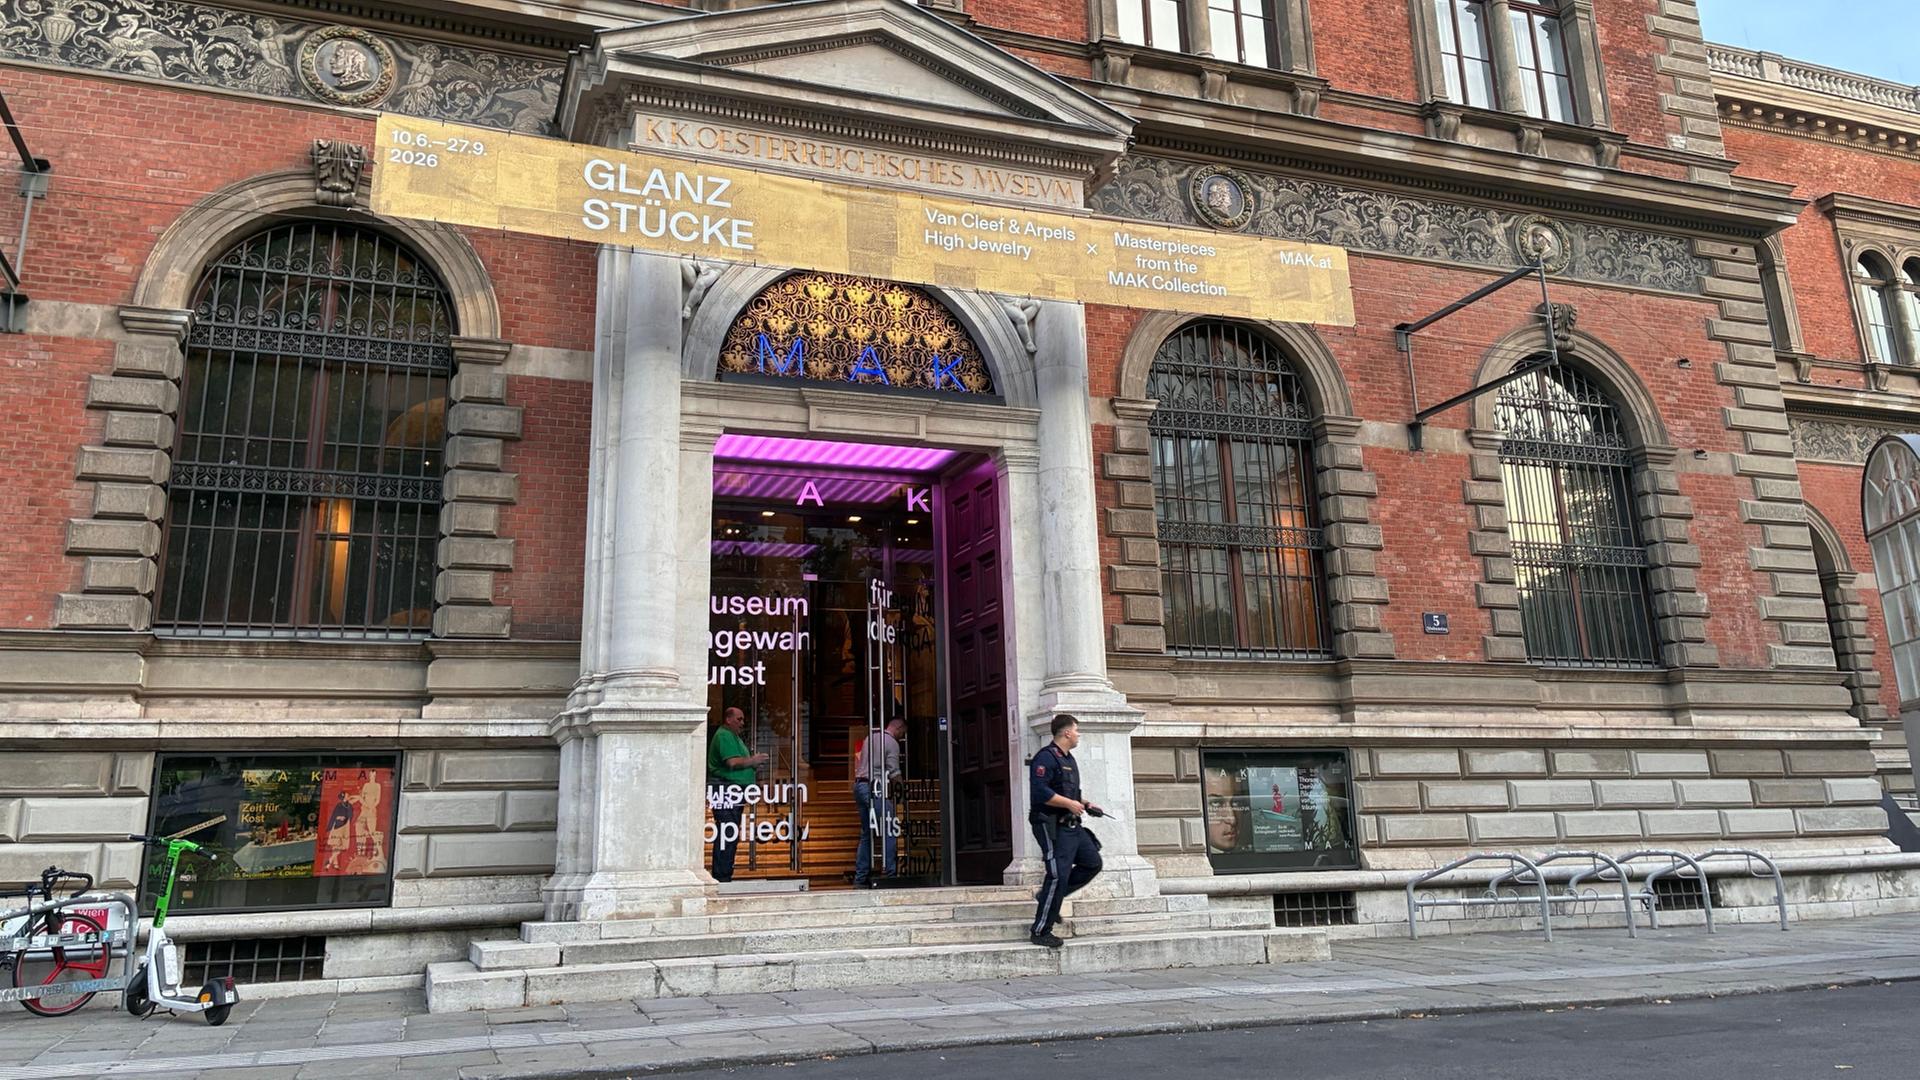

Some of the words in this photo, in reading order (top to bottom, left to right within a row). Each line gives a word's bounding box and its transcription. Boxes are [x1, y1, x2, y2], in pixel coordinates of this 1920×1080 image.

[390, 149, 438, 167] 2026
[696, 126, 964, 187] OESTERREICHISCHES
[583, 159, 732, 208] GLANZ
[582, 198, 754, 250] STÜCKE
[925, 208, 957, 226] Van
[961, 212, 1005, 233] Cleef
[1009, 219, 1020, 234] &
[1024, 221, 1076, 241] Arpels
[925, 229, 964, 250] High
[968, 236, 1032, 260] Jewelry
[1113, 232, 1216, 257] Masterpieces
[1135, 254, 1170, 272] from
[1173, 259, 1198, 274] the
[1280, 251, 1332, 270] MAK.at
[1108, 271, 1149, 289] MAK
[1152, 276, 1227, 296] Collection
[711, 595, 808, 617] useum
[1433, 615, 1440, 627] 5
[707, 630, 810, 658] gewan
[707, 660, 766, 686] unst
[707, 784, 808, 804] useum
[241, 813, 265, 823] Kost
[242, 803, 263, 812] Zeit
[265, 803, 279, 812] für
